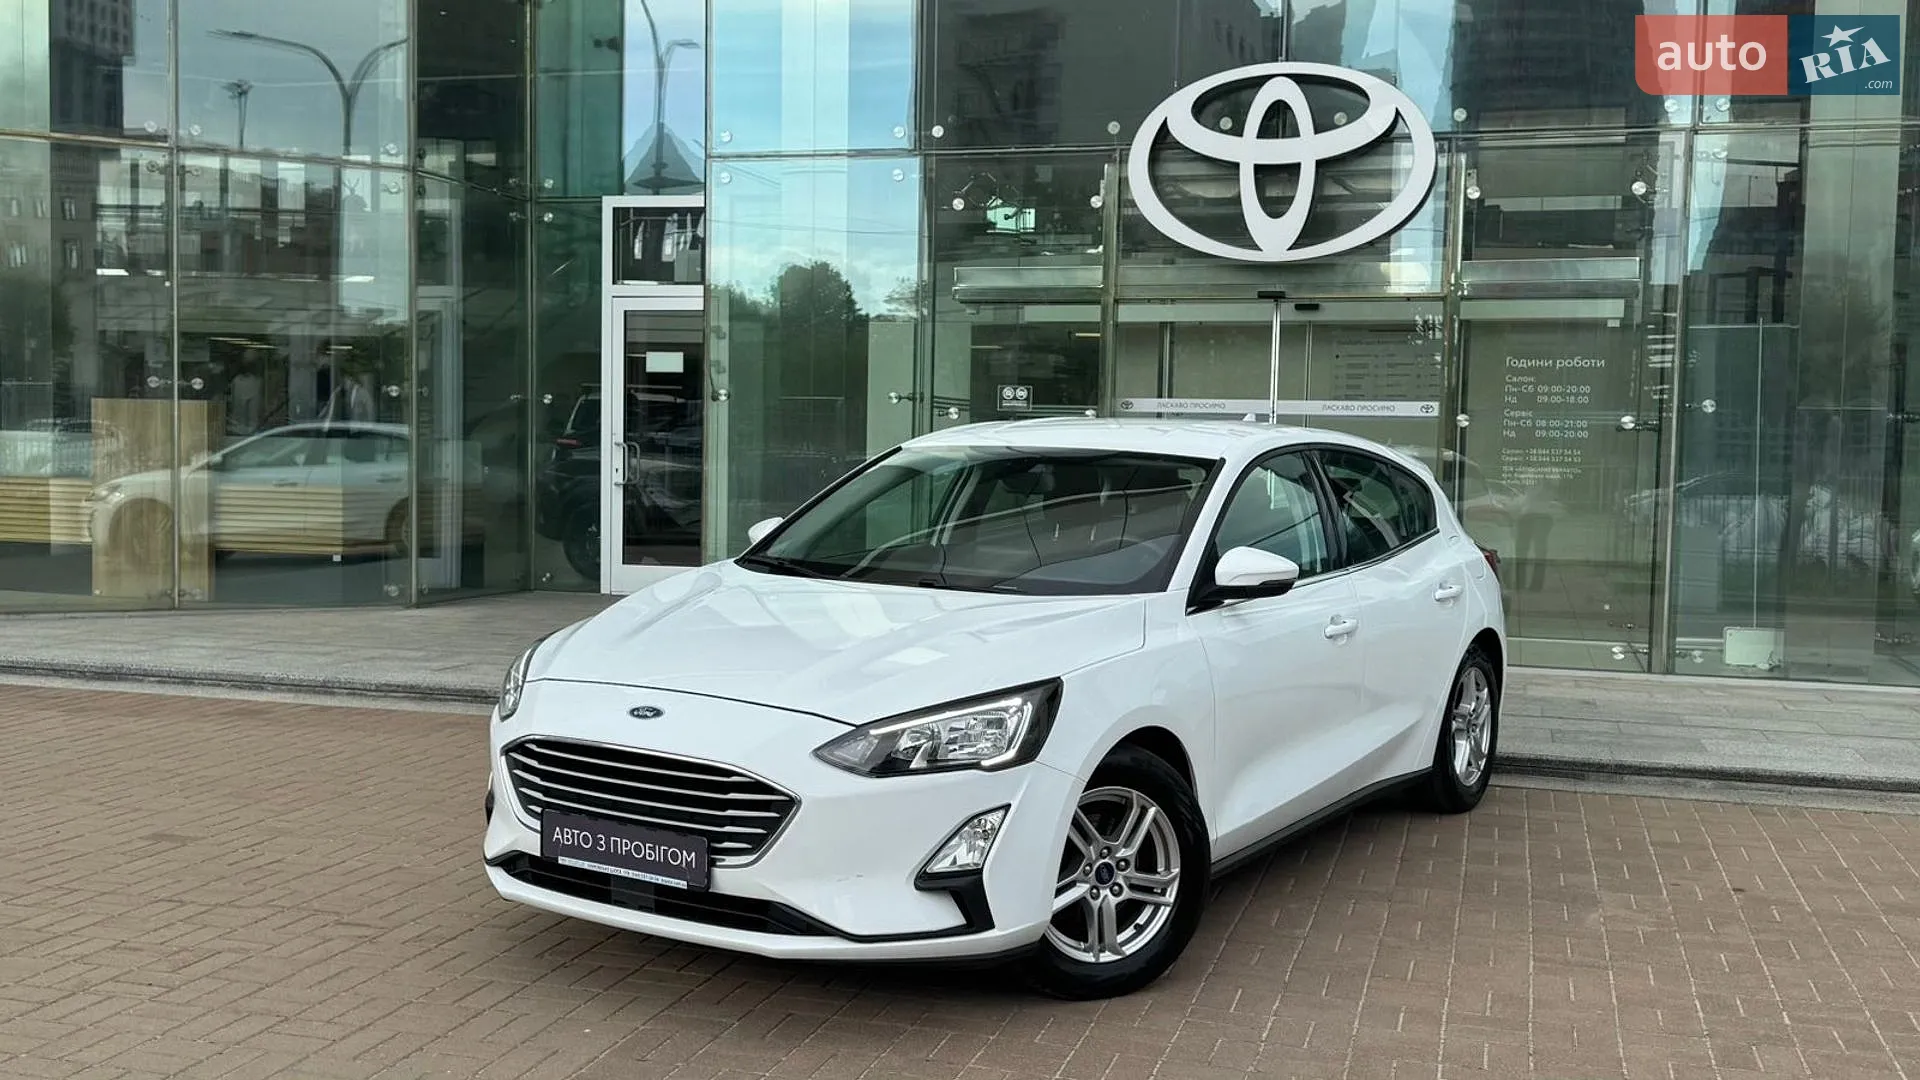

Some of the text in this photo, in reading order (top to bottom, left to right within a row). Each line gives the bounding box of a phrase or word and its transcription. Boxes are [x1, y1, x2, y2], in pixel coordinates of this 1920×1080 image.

[1505, 356, 1605, 370] Години роботи
[552, 826, 593, 849] АВТО
[610, 836, 696, 869] ПРОБІГОМ
